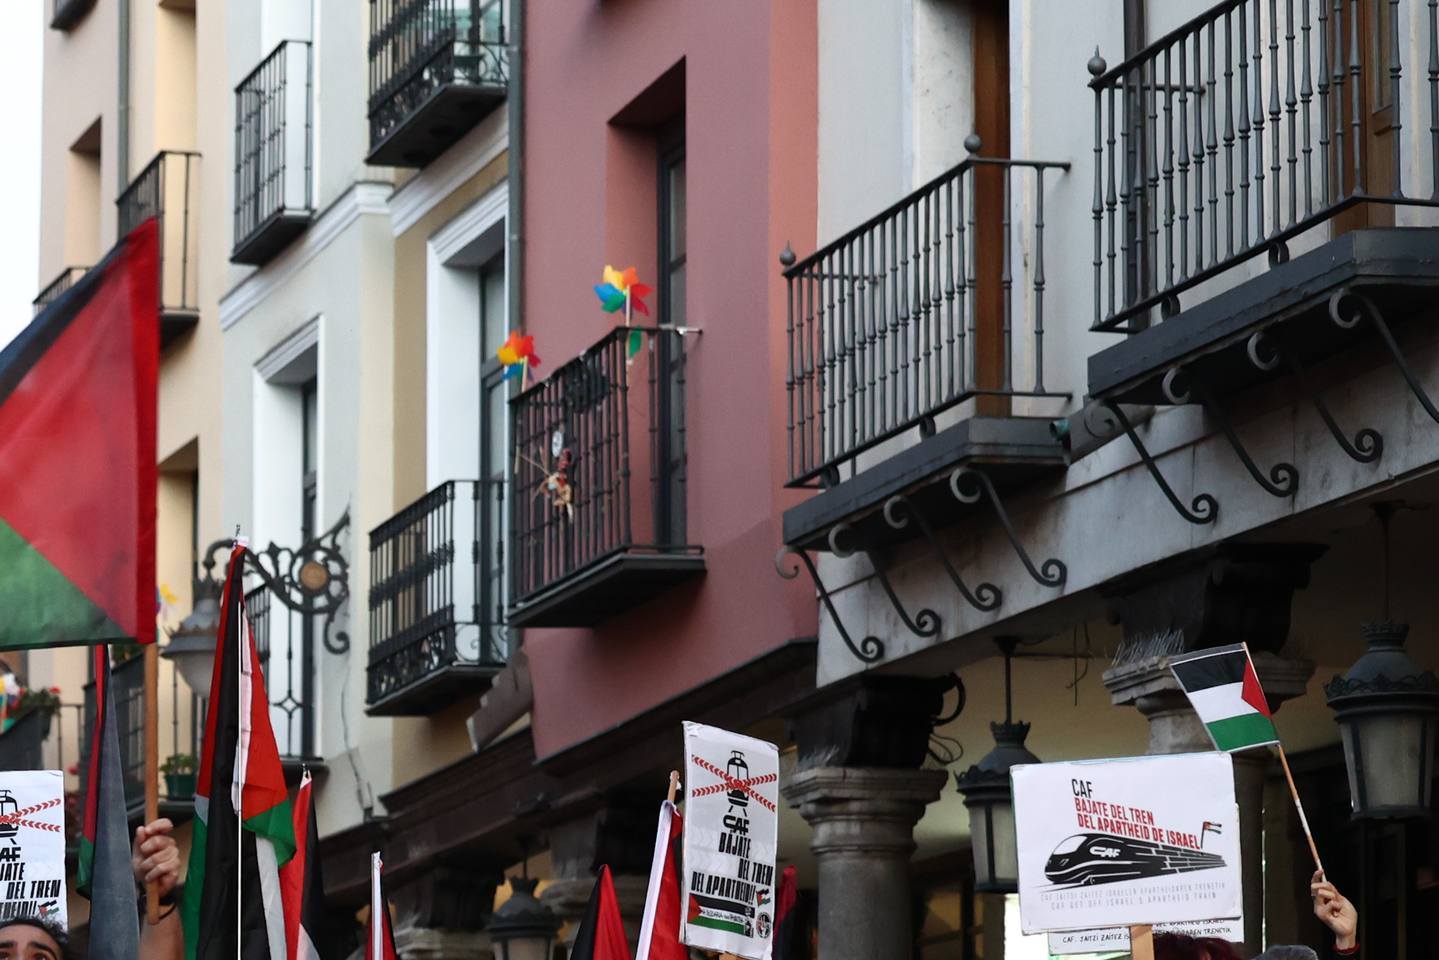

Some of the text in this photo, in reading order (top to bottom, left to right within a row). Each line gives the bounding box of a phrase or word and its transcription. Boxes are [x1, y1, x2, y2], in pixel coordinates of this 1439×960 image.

[1072, 778, 1092, 798] CAF
[723, 814, 750, 835] CAF
[1111, 805, 1128, 820] DEL
[1130, 808, 1154, 826] TREN
[1078, 813, 1200, 850] DEL APARTHEID DE ISRAEL
[718, 830, 752, 860] BÁJATE
[1090, 846, 1120, 858] CAF
[738, 858, 774, 886] DEL TREN
[6, 880, 62, 900] DEL TREN
[691, 871, 756, 906] DEL APARTHEID!!
